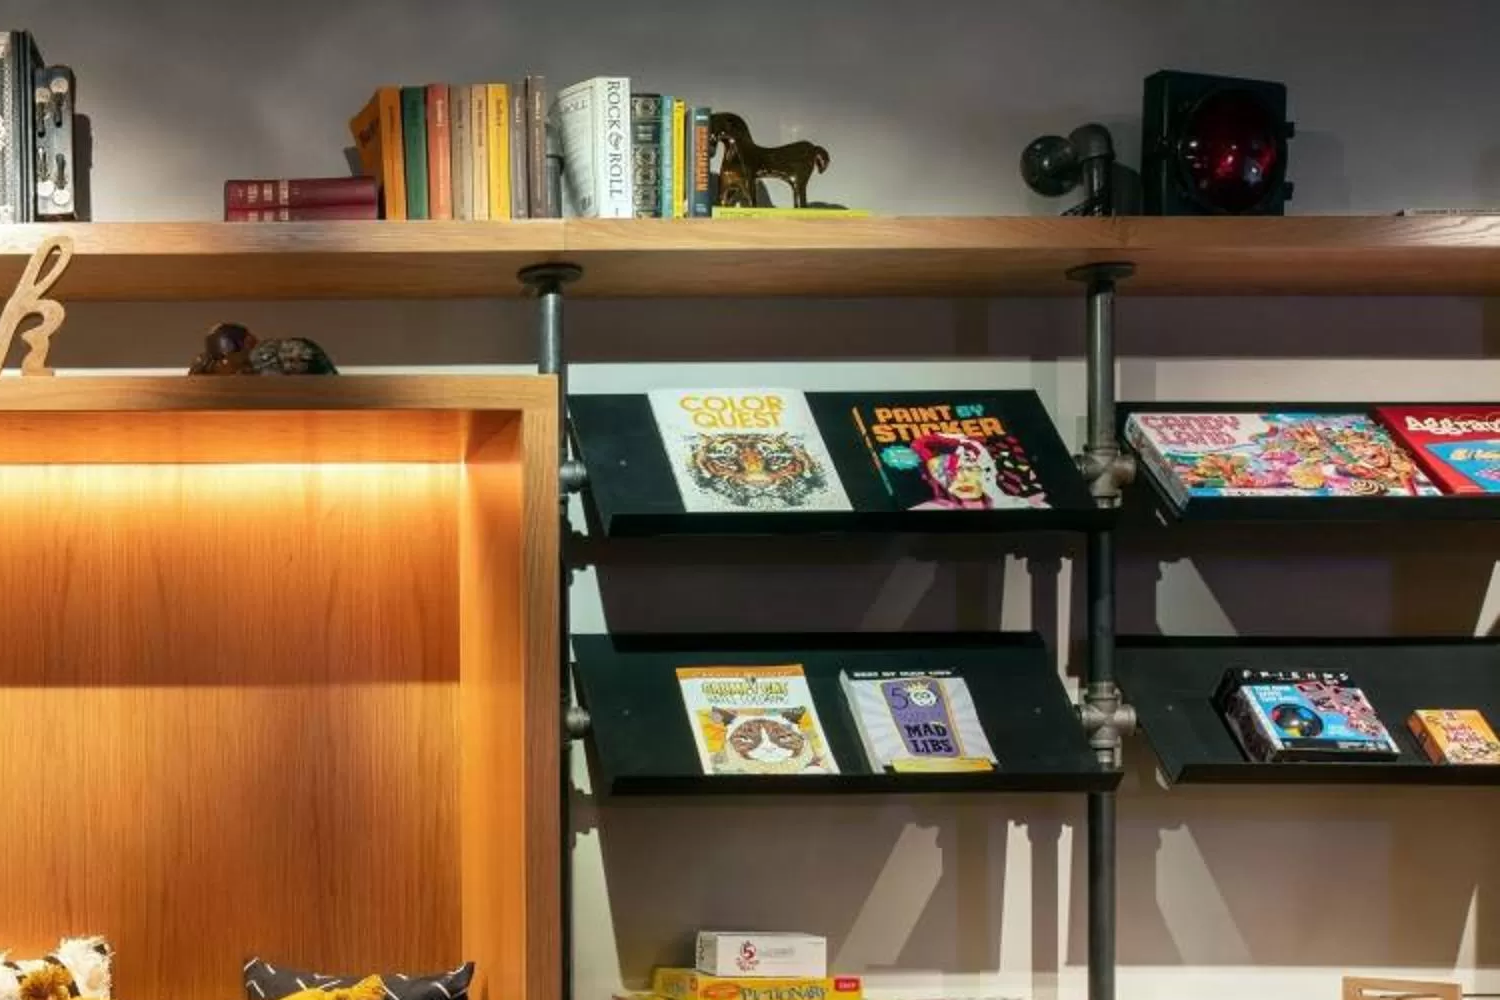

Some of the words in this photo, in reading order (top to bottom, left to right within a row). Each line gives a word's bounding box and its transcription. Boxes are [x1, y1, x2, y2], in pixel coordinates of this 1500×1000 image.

[607, 81, 622, 130] ROCK
[609, 152, 623, 198] ROLL
[678, 394, 788, 413] COLOR
[692, 410, 782, 430] QUEST
[874, 405, 952, 424] PAINT
[955, 404, 984, 418] BY
[871, 418, 1006, 444] STICKER
[904, 723, 947, 739] MAD
[910, 739, 954, 754] LIBS
